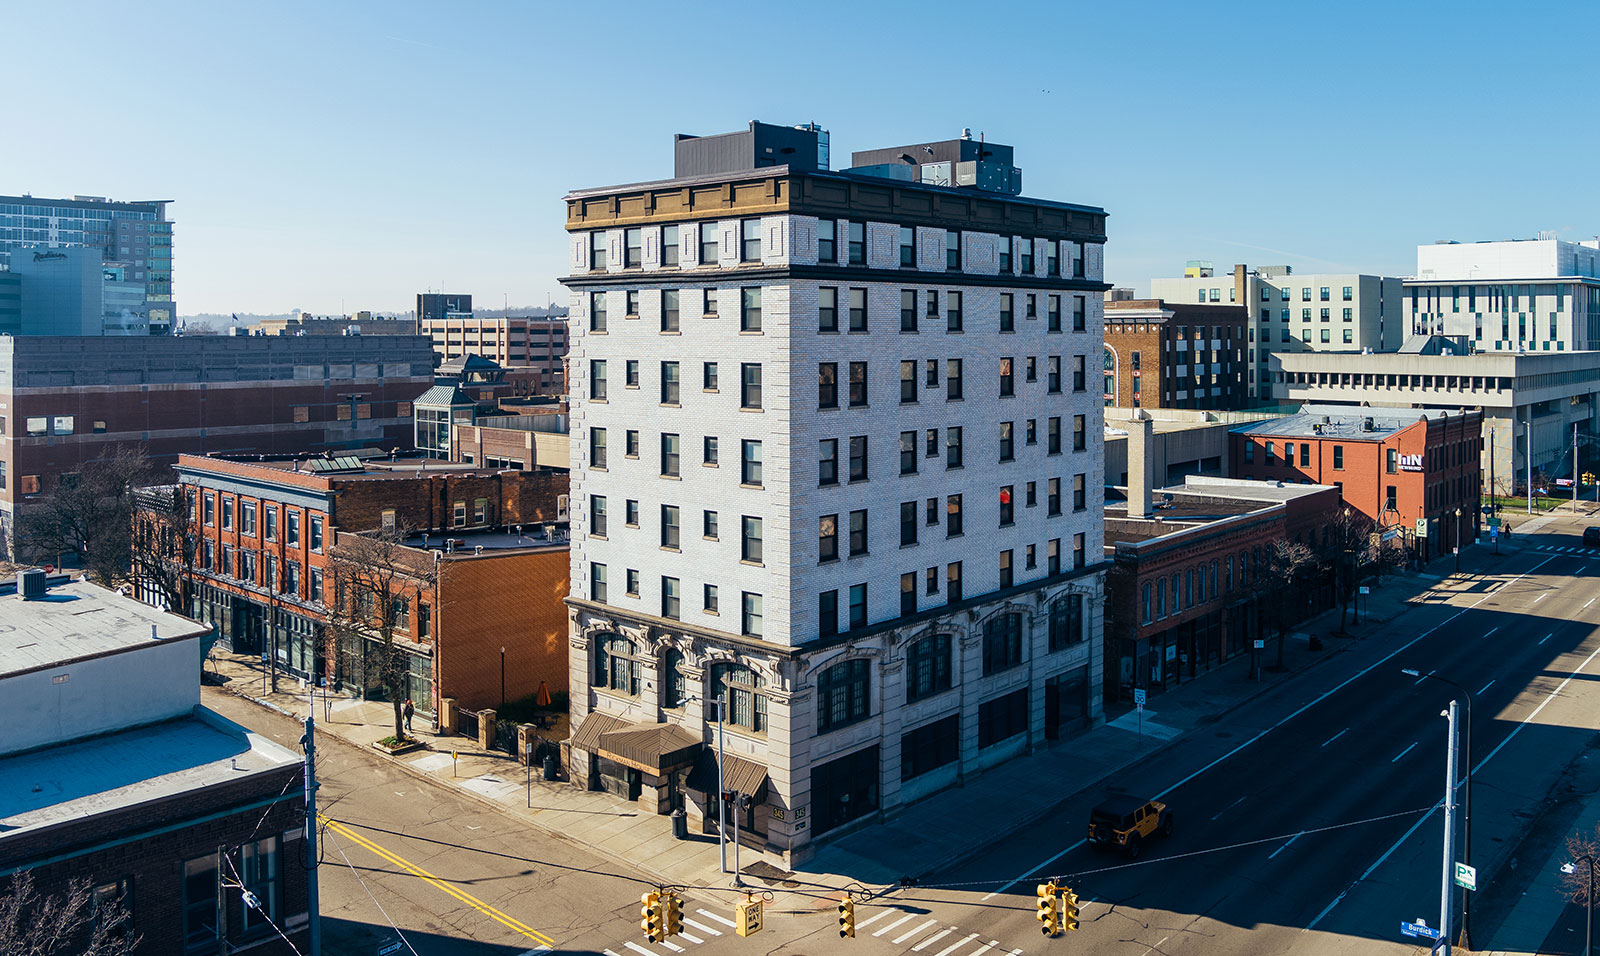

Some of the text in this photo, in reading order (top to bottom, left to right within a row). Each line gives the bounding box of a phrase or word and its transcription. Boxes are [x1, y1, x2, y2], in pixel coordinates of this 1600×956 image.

[1136, 695, 1145, 703] 30
[774, 807, 784, 819] 345
[1457, 865, 1466, 877] P
[748, 904, 760, 916] ONE
[748, 912, 760, 923] WAY
[1408, 923, 1433, 935] Burdick
